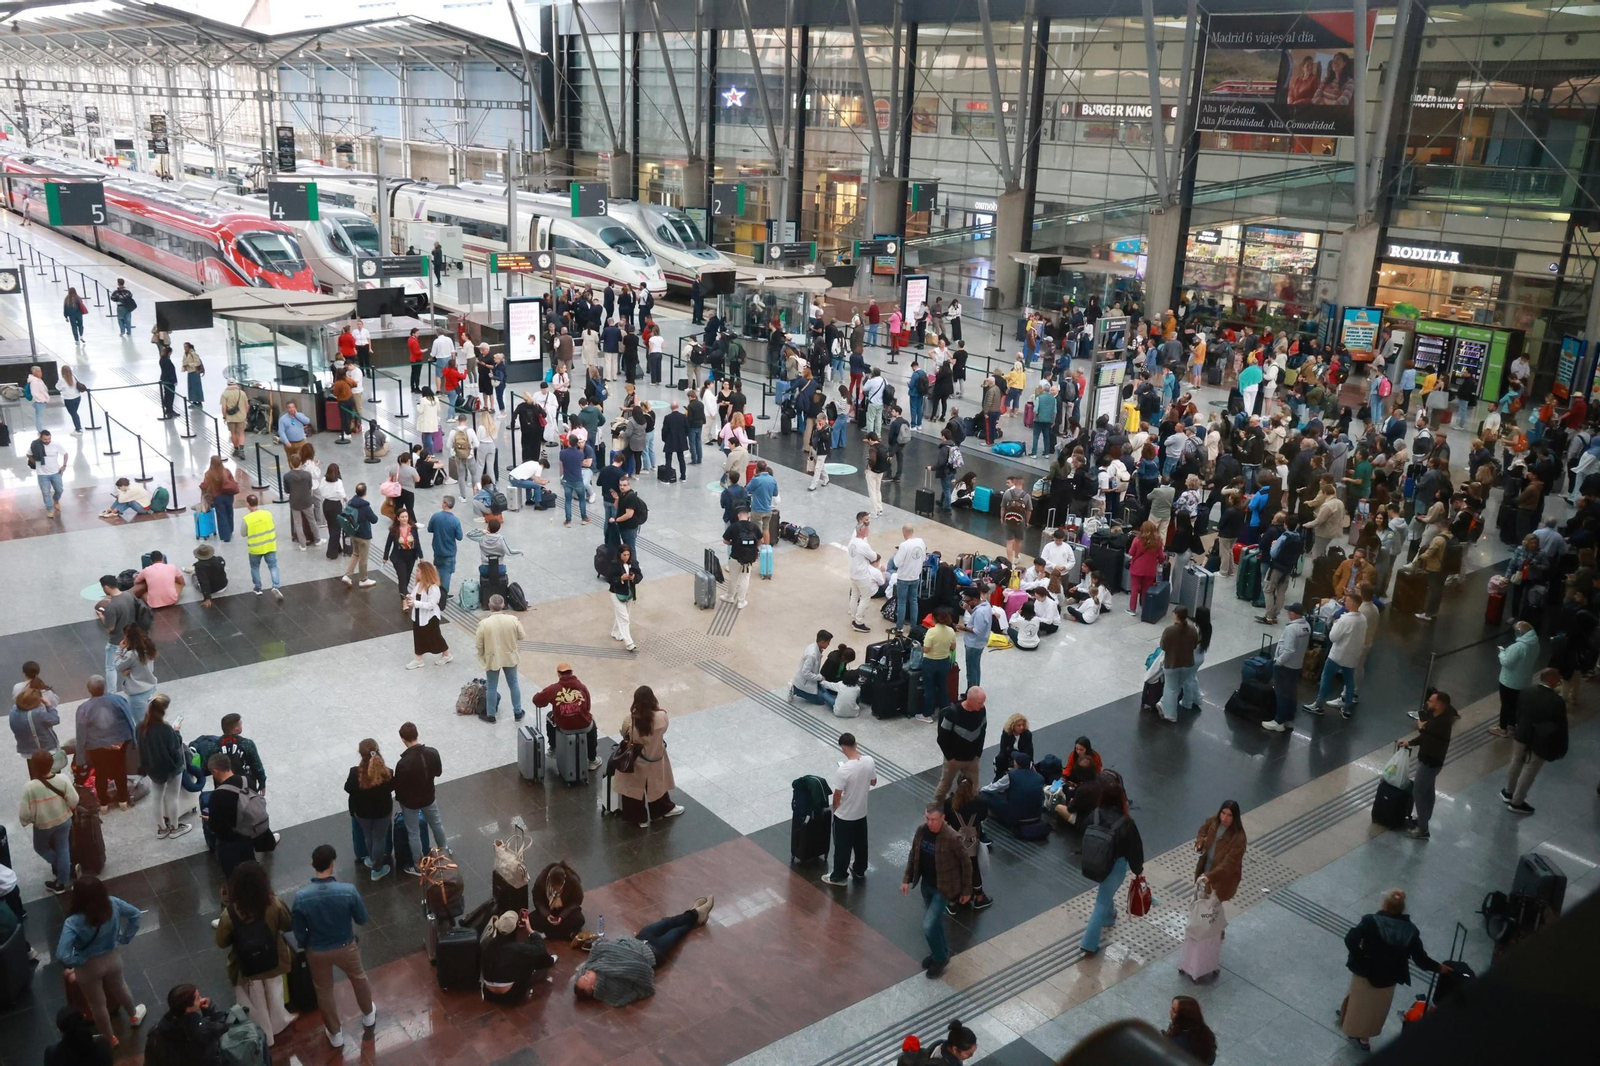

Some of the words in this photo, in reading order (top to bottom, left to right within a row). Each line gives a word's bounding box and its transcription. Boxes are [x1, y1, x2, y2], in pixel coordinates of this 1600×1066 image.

[1211, 31, 1247, 43] Madrid
[1246, 32, 1253, 42] 6
[1255, 31, 1283, 45] viajes
[1285, 32, 1295, 43] al
[1297, 31, 1317, 43] día.
[1082, 103, 1124, 117] BURGER
[1125, 104, 1153, 118] KING
[1202, 104, 1217, 113] Alta
[1218, 104, 1256, 115] Velocidad.
[1200, 116, 1216, 125] Alta
[1216, 116, 1266, 128] Flexibilidad.
[1268, 119, 1284, 129] Alta
[1285, 120, 1336, 130] Comodidad.
[272, 201, 285, 219] 4
[597, 199, 606, 216] 3
[714, 199, 722, 215] 2
[929, 197, 936, 211] 1
[91, 204, 105, 224] 5
[1389, 245, 1460, 264] RODILLA
